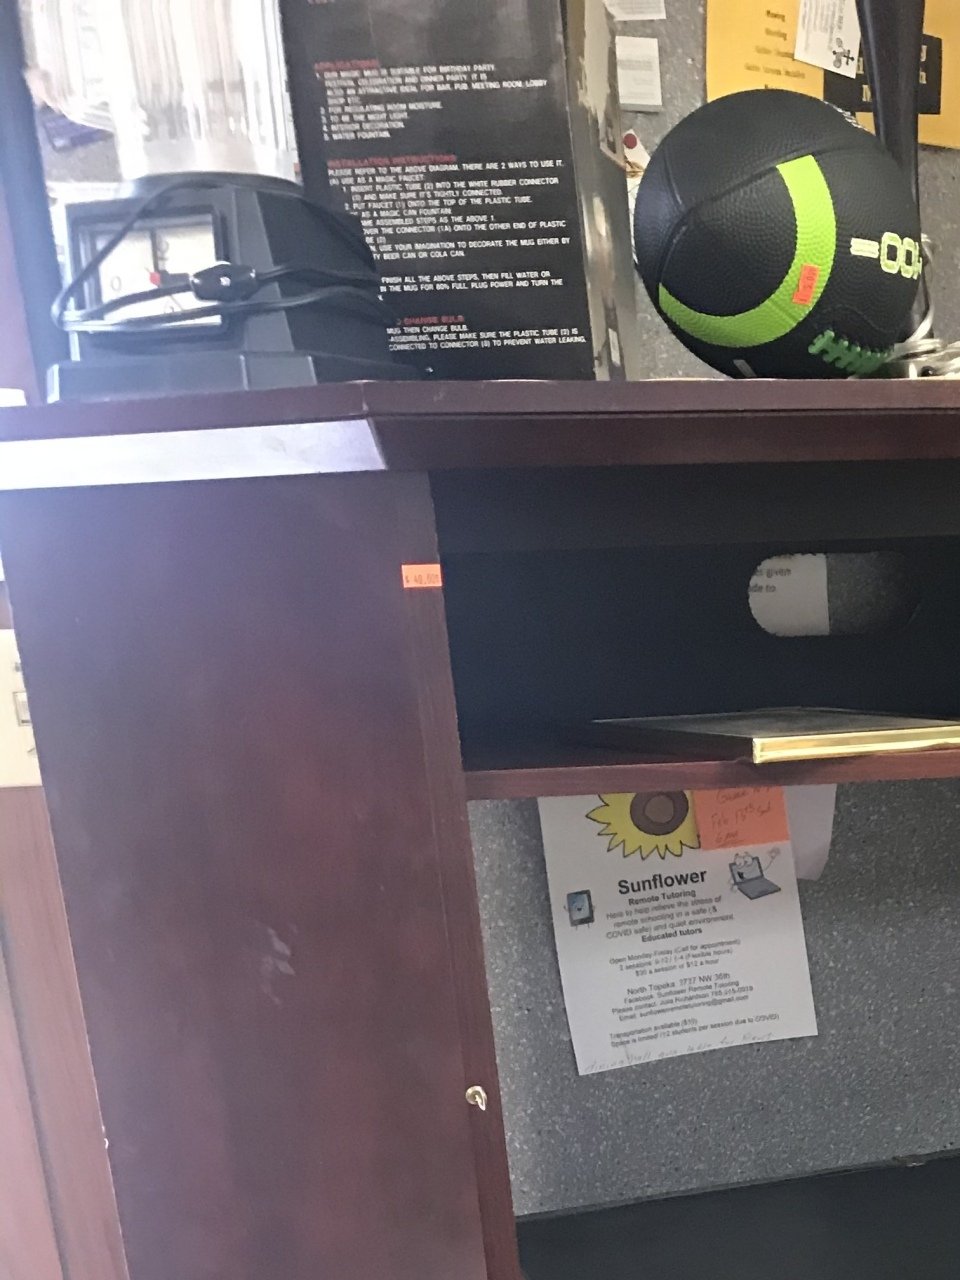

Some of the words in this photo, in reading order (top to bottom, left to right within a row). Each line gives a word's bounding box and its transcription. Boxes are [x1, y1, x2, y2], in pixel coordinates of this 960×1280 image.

[462, 163, 483, 171] THERE
[485, 162, 499, 170] ARE
[501, 162, 506, 170] 2
[507, 161, 528, 169] WAYS
[529, 160, 540, 168] TO
[540, 159, 554, 168] USE
[528, 220, 538, 229] OF
[539, 219, 567, 228] PLASTIC
[513, 329, 540, 337] PLASTIC
[618, 870, 707, 895] Sunflower
[628, 896, 660, 906] Remote
[661, 889, 697, 900] Tutoring
[641, 931, 678, 943] Educated
[679, 927, 703, 937] tutors
